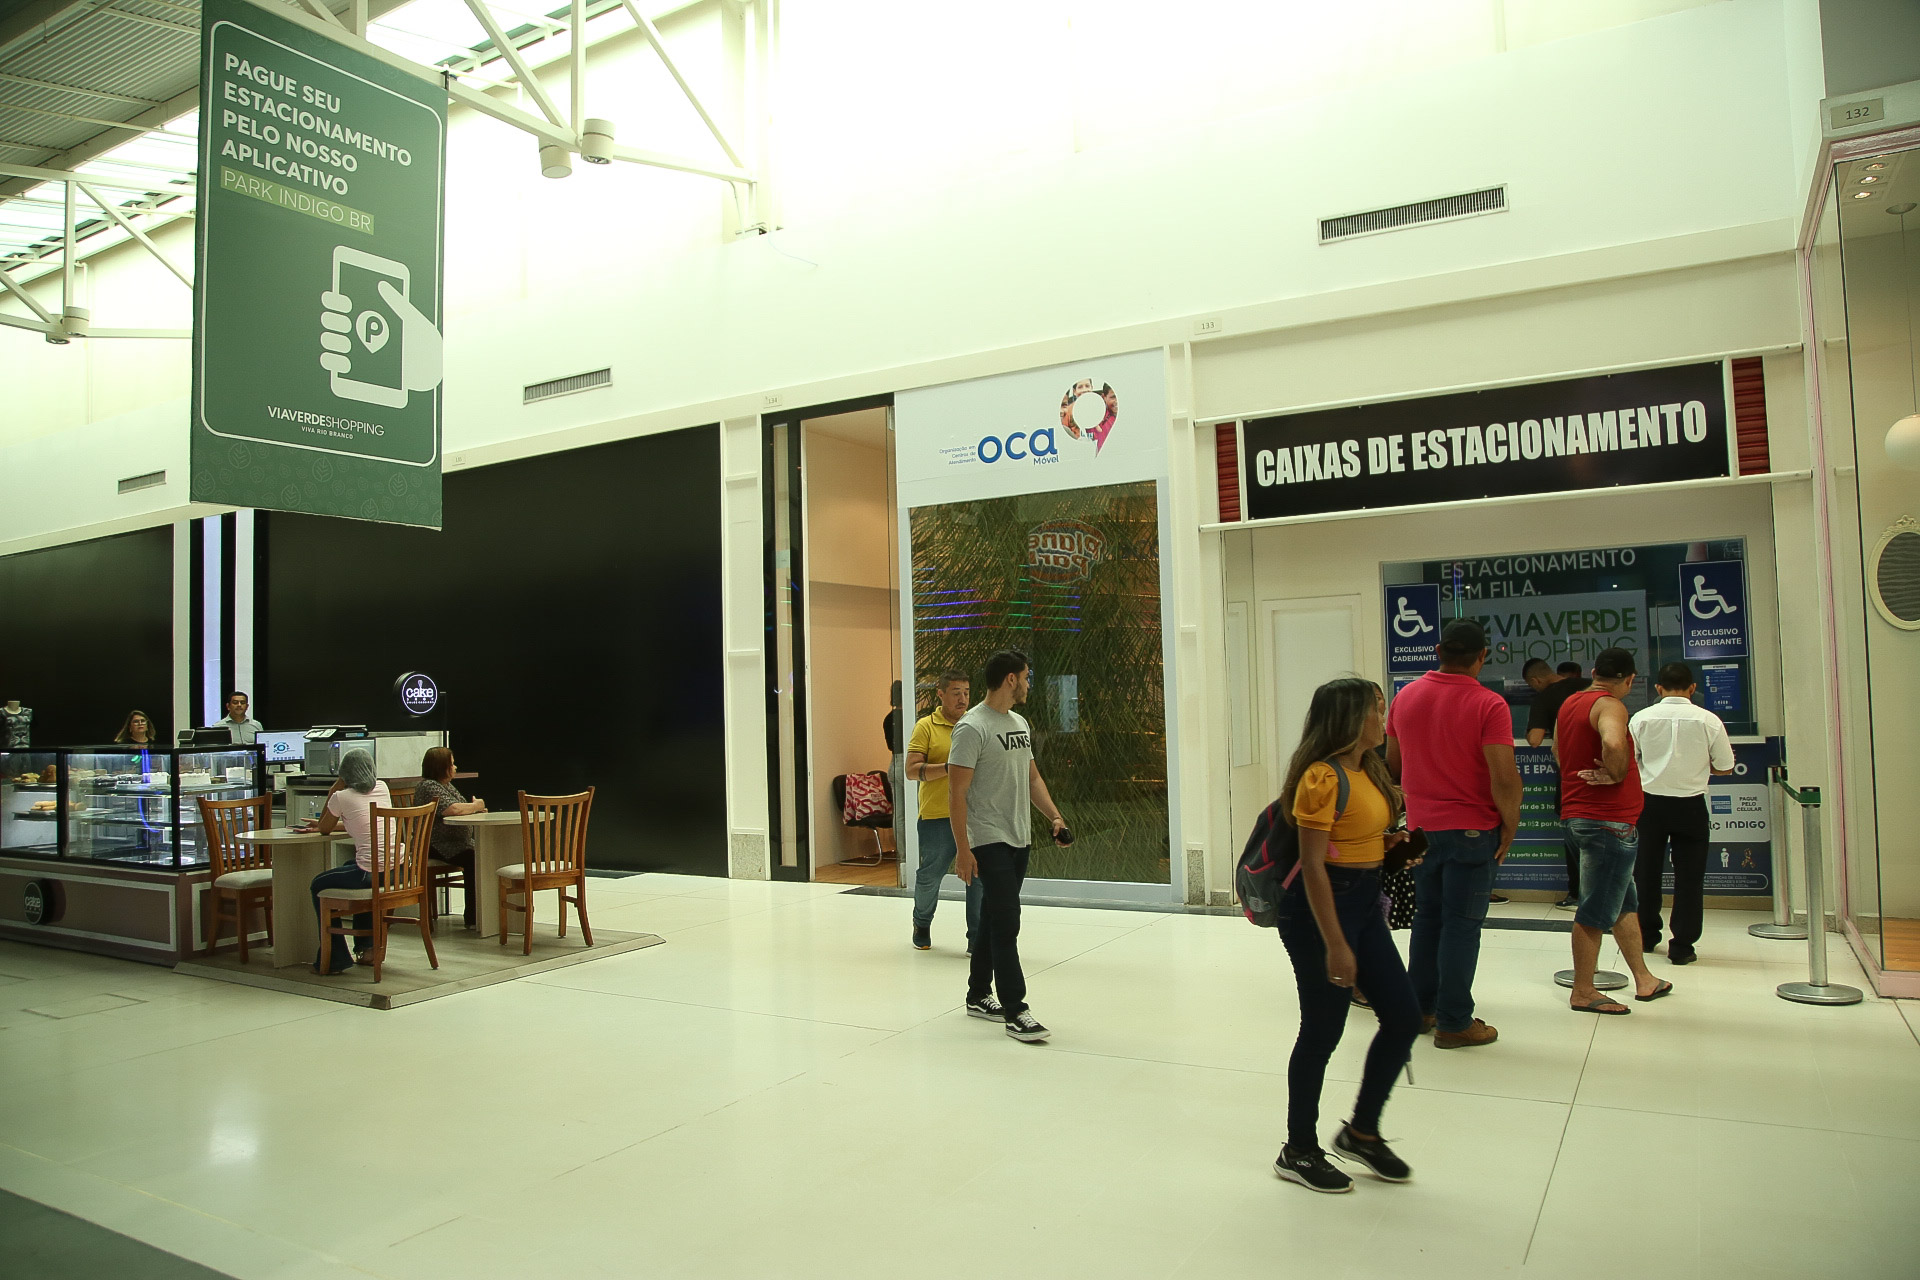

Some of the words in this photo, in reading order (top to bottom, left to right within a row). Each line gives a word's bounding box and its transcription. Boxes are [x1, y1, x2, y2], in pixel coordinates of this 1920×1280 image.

[225, 52, 297, 98] PAGUE
[302, 85, 341, 114] SEU
[1845, 107, 1870, 120] 132
[224, 81, 412, 167] ESTACIONAMENTO
[223, 109, 281, 145] PELO
[286, 132, 358, 172] NOSSO
[221, 139, 349, 196] APLICATIVO
[224, 170, 273, 201] PARK
[279, 188, 344, 222] INDIGO
[350, 211, 371, 231] BR
[1202, 321, 1215, 330] 133
[267, 405, 385, 437] VIAVERDESHOPPING
[301, 425, 315, 434] VIVA
[316, 428, 328, 436] RIO
[328, 430, 354, 440] BRANCO
[977, 427, 1059, 464] oca
[1256, 439, 1361, 487] CAIXAS
[1368, 433, 1404, 475] DE
[1413, 400, 1708, 471] ESTACIONAMENTO
[1033, 455, 1059, 466] Móvel
[1441, 548, 1636, 580] ESTACIONAMENTO
[1441, 581, 1483, 602] SEM
[1490, 579, 1542, 599] FILA.
[1691, 628, 1738, 637] EXCLUSIVO
[1394, 645, 1435, 653] EXCLUSIVO
[1688, 637, 1742, 647] CADEIRANTE
[406, 685, 434, 698] cake
[996, 731, 1030, 751] VANS
[1515, 754, 1557, 764] ERMINAIS
[1524, 765, 1530, 774] E
[1726, 820, 1766, 830] INDIGO
